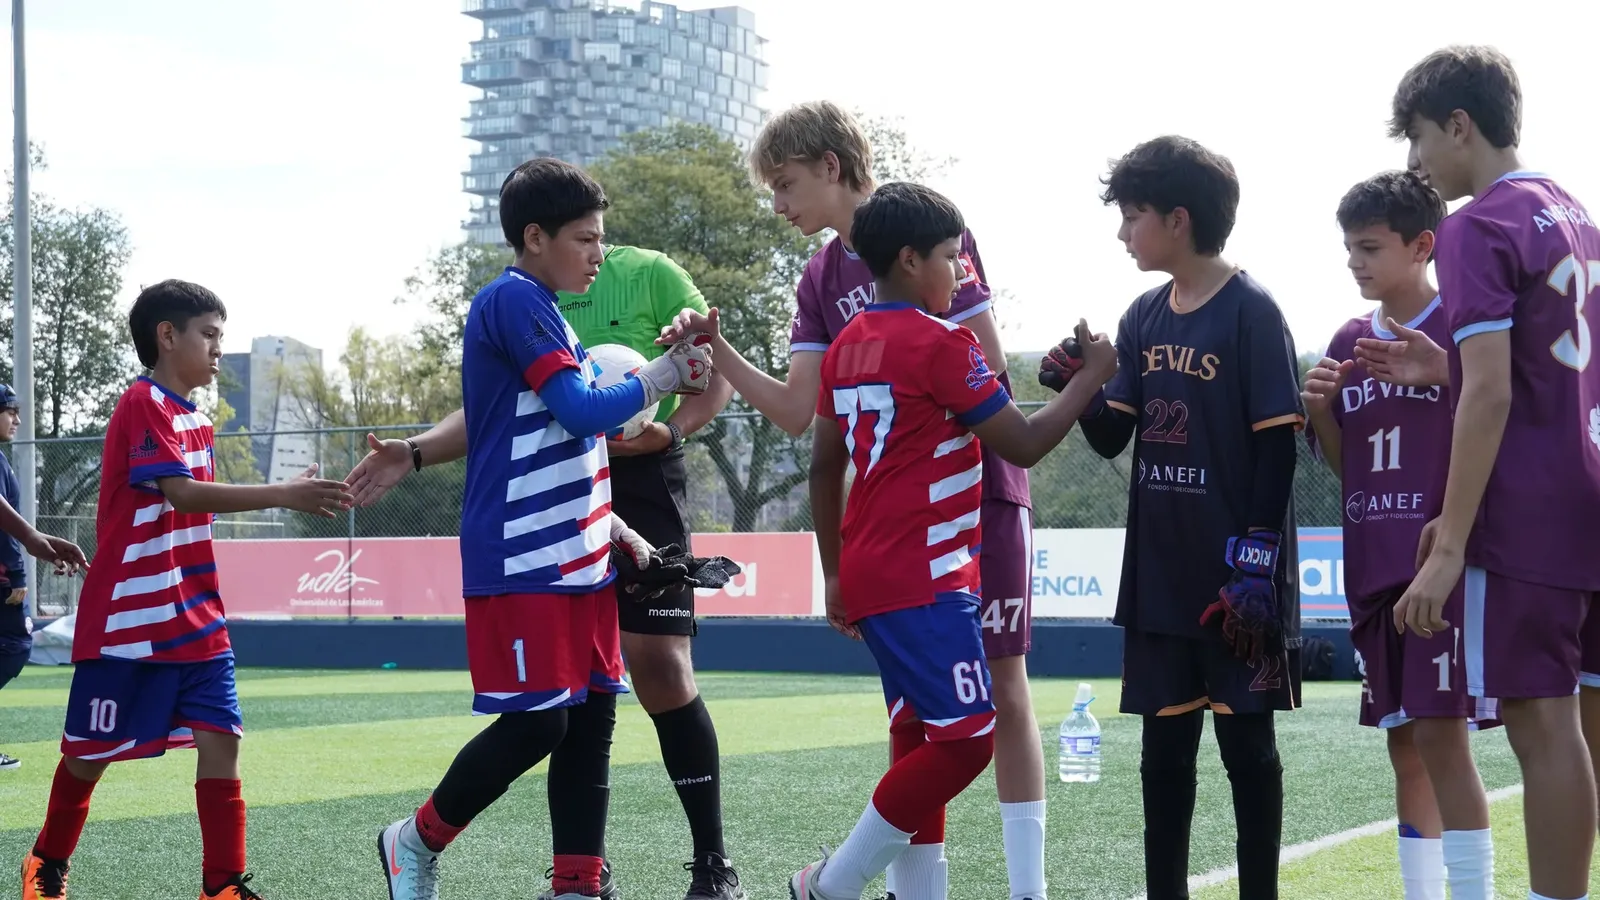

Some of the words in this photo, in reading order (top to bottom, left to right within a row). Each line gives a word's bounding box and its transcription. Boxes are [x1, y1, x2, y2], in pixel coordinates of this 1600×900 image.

[558, 300, 593, 312] arathon
[832, 382, 897, 481] 77
[1141, 398, 1189, 444] 22
[1367, 425, 1402, 473] 11
[1150, 464, 1205, 485] ANEFI
[1367, 493, 1423, 512] ANEF
[1238, 546, 1271, 567] RICKY
[648, 607, 691, 617] marathon
[982, 597, 1024, 634] 47
[512, 638, 526, 682] 1
[952, 660, 989, 704] 61
[89, 698, 117, 733] 10
[673, 774, 712, 786] rathon
